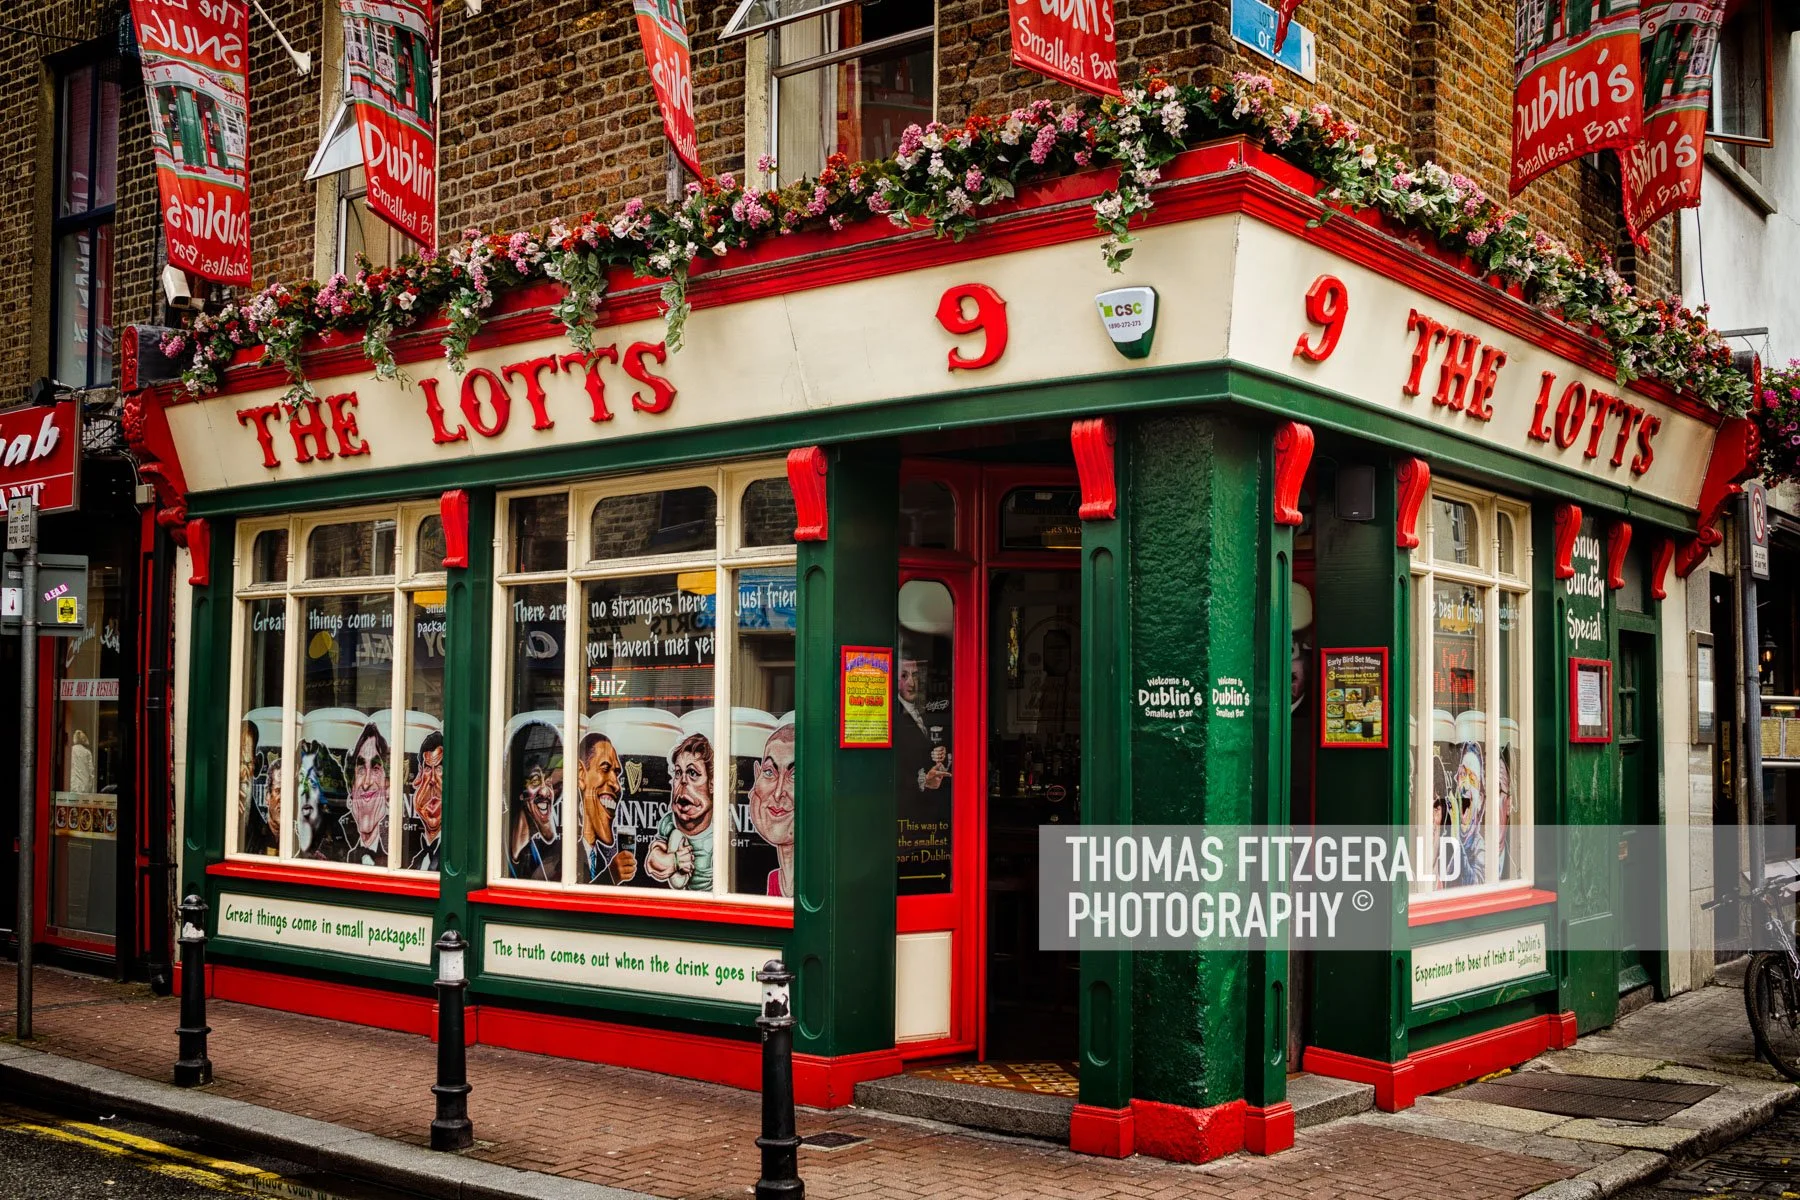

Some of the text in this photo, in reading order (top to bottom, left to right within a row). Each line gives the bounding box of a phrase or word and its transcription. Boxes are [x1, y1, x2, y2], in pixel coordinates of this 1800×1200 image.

[1018, 16, 1084, 78] Smallest
[1517, 115, 1631, 179] Smallest Bar
[370, 176, 417, 231] Smallest
[1656, 178, 1691, 207] Bar
[1115, 302, 1143, 317] CSC
[936, 283, 1007, 372] 9
[1294, 274, 1662, 475] 9 THE LOTTS
[236, 340, 678, 469] THE LOTTS
[513, 599, 545, 622] There
[549, 604, 567, 620] are
[591, 600, 607, 618] no
[611, 595, 673, 625] strangers
[677, 588, 707, 613] here
[735, 585, 762, 617] just
[1438, 594, 1454, 621] best
[1456, 597, 1465, 623] of
[1466, 599, 1483, 624] Irish
[253, 609, 393, 637] Great things come in
[1567, 607, 1602, 650] Special
[585, 631, 715, 668] you haven't met yet
[1327, 658, 1342, 667] Early
[1342, 655, 1354, 664] Bird
[1355, 655, 1365, 664] Set
[1461, 648, 1468, 670] 2
[1147, 675, 1190, 687] Welcome to
[1328, 670, 1335, 680] 3
[1138, 686, 1203, 706] Dublin's
[1212, 686, 1250, 706] Dublin's
[1145, 707, 1194, 719] Smallest Bar
[898, 818, 949, 834] This way to
[898, 832, 948, 847] the smallest
[911, 851, 919, 862] in
[225, 904, 426, 952] Great things come in small packages!!
[1517, 933, 1542, 954] Dublin's
[493, 939, 513, 957] The
[517, 942, 545, 961] truth
[550, 949, 586, 965] comes
[591, 952, 609, 967] out
[615, 951, 645, 971] when
[650, 955, 670, 973] the
[675, 957, 710, 977] drink
[715, 967, 745, 986] goes
[1415, 947, 1515, 987] Experience the best of Irish at
